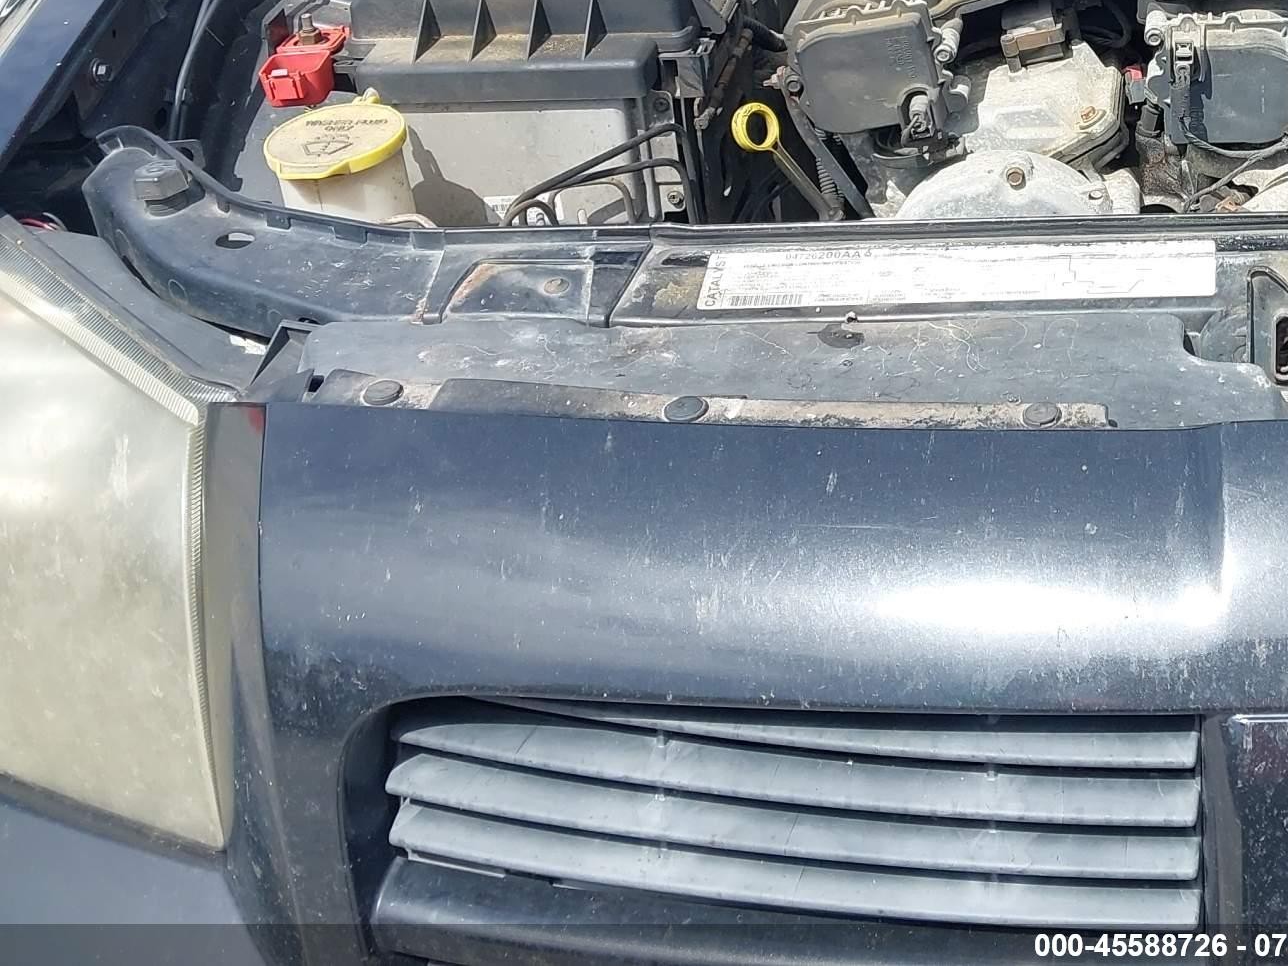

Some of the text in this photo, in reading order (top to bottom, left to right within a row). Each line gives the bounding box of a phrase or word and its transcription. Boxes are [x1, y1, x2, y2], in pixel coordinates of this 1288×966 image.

[305, 118, 388, 127] WASHER FLUID
[704, 251, 727, 308] CATALYST
